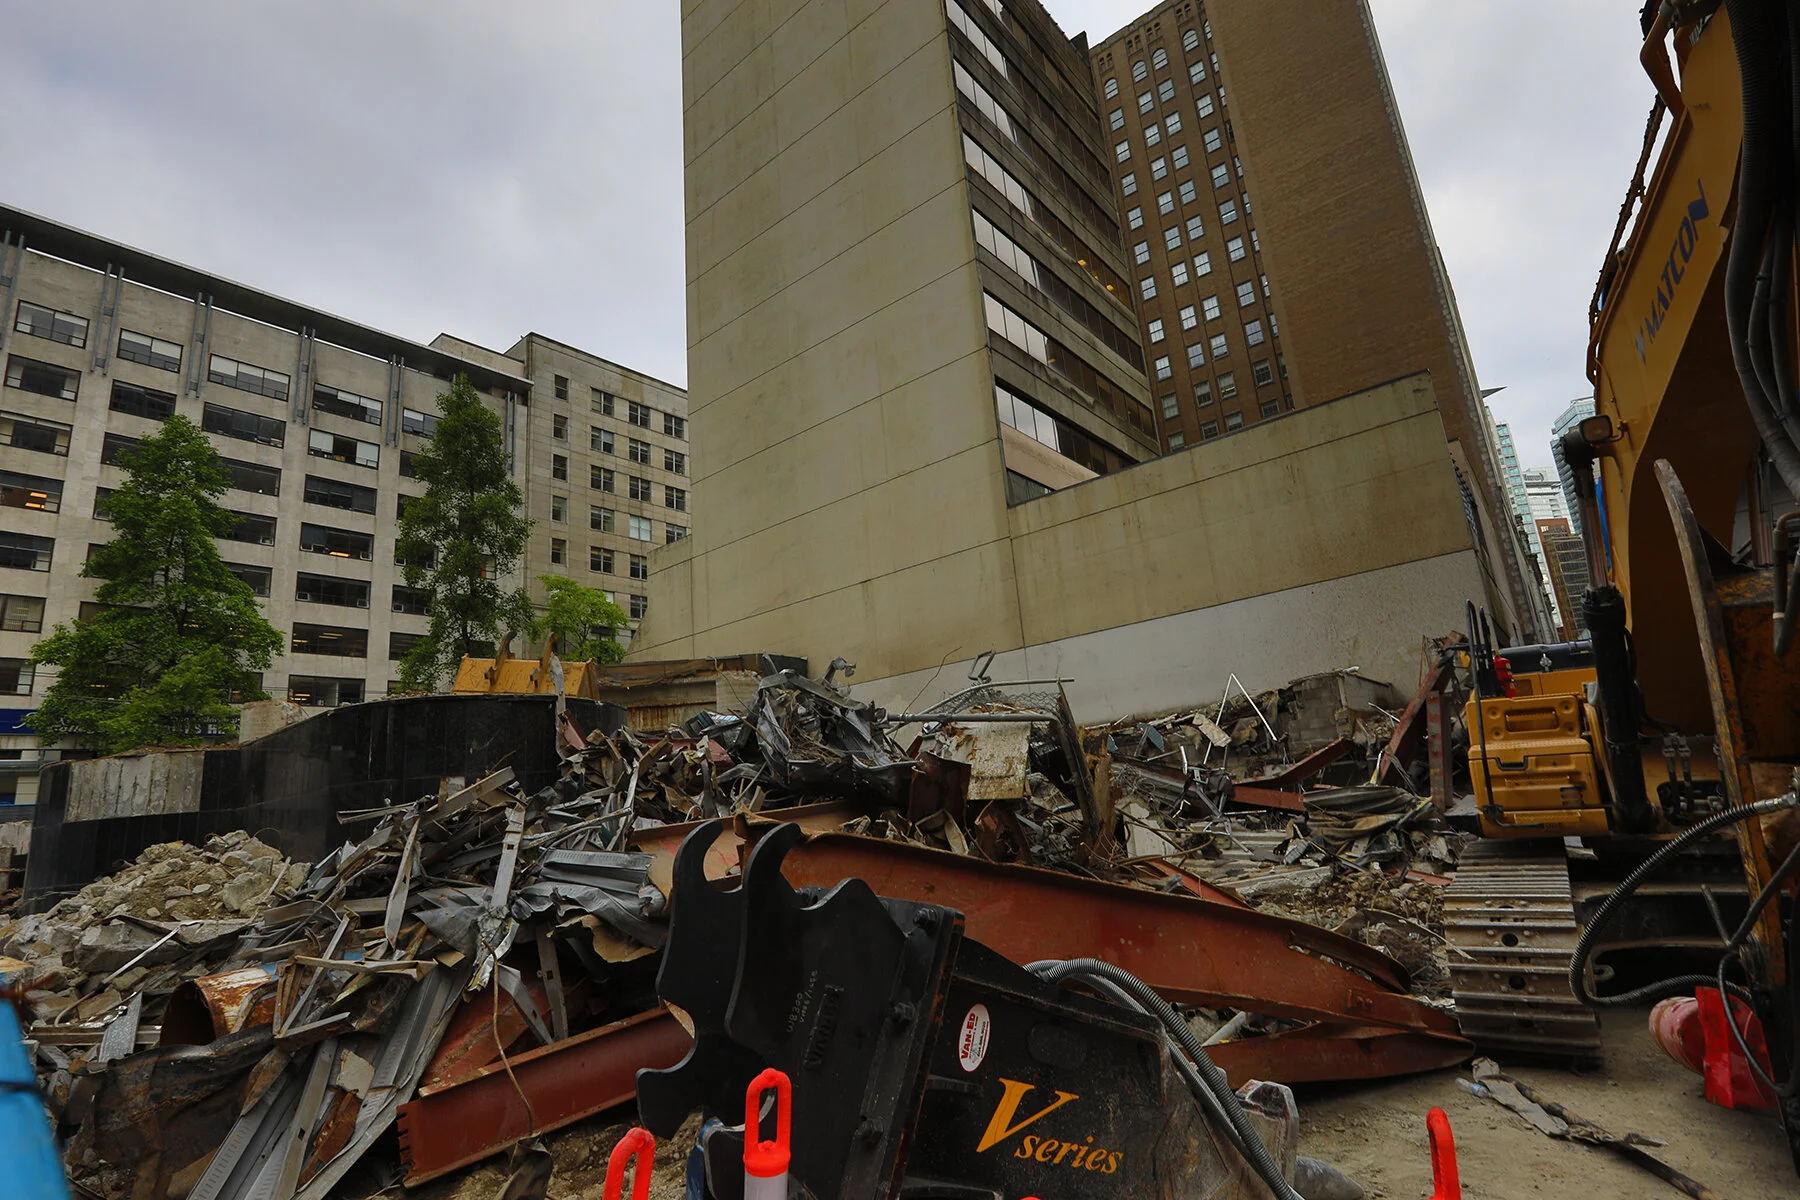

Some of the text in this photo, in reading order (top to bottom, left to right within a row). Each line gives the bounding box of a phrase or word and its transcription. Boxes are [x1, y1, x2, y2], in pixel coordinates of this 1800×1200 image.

[1644, 179, 1710, 345] MATCON
[976, 1077, 1124, 1174] V series
